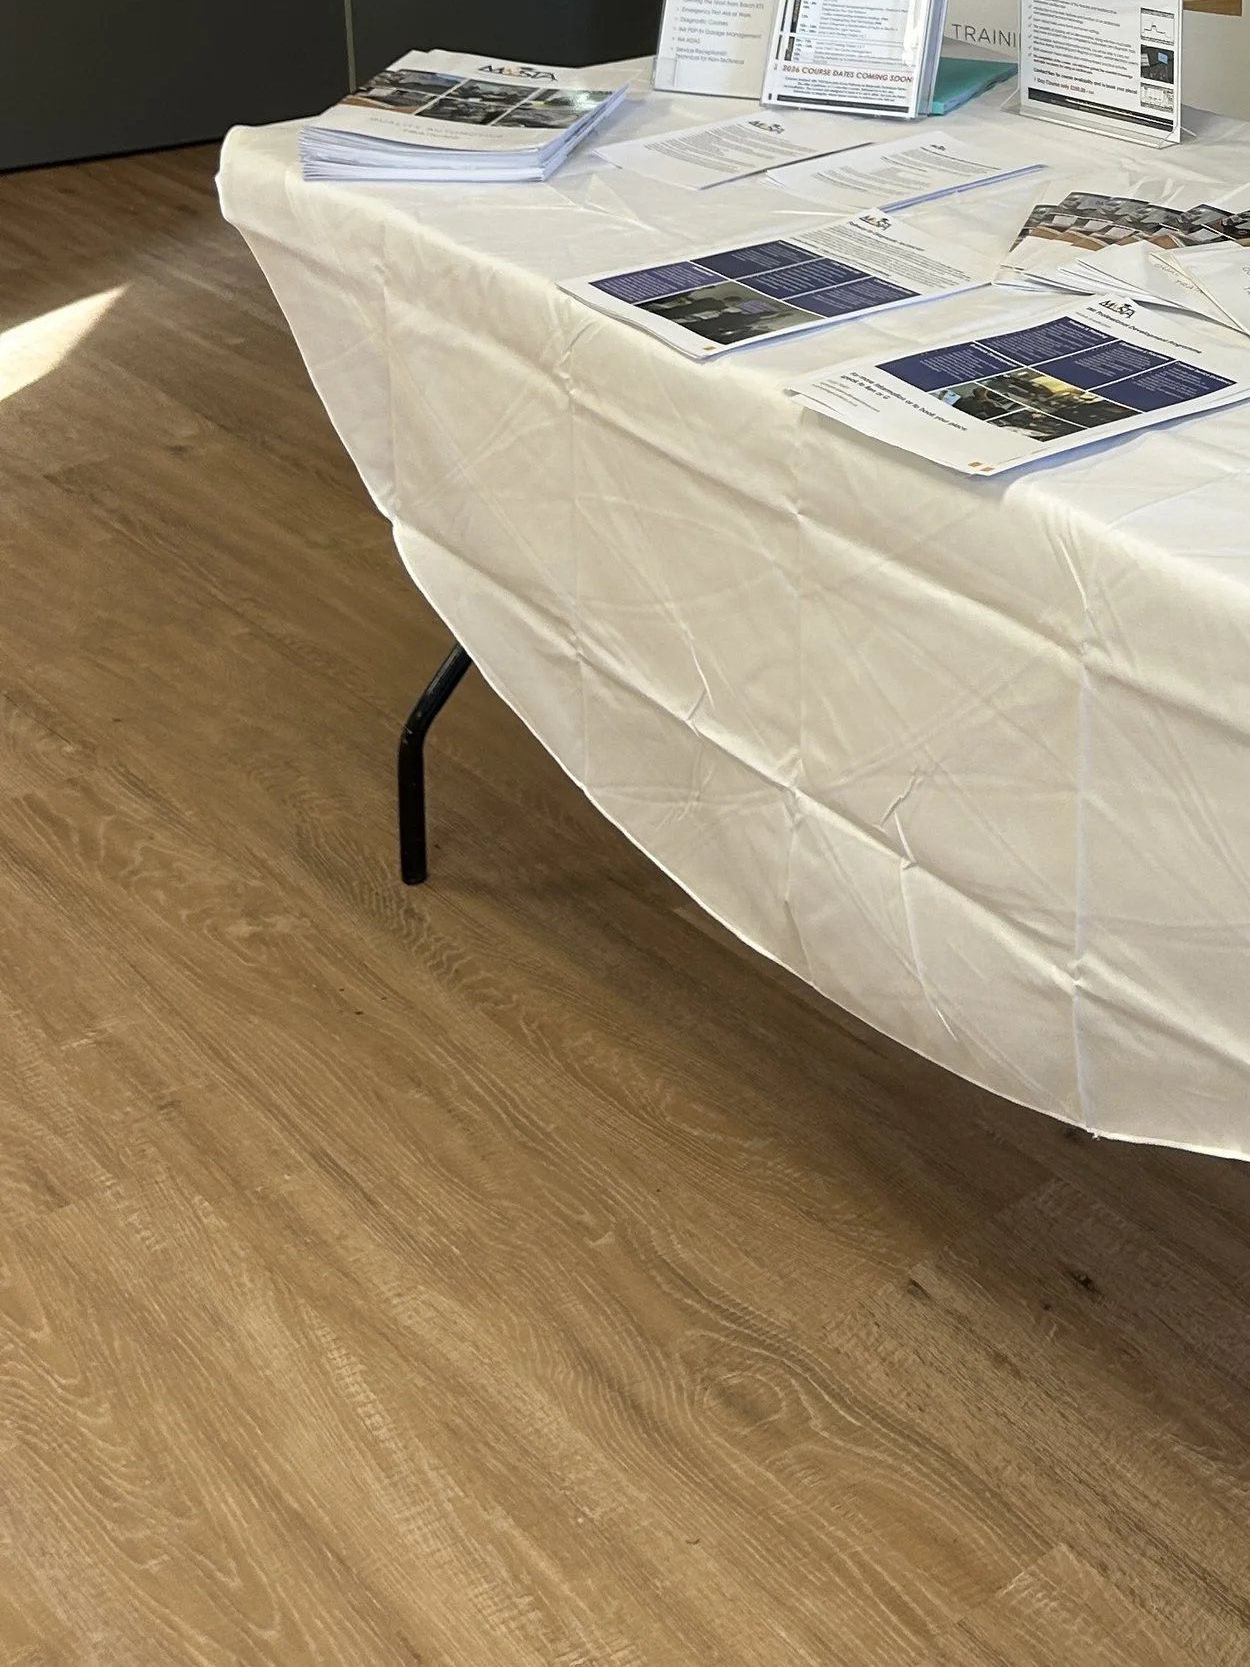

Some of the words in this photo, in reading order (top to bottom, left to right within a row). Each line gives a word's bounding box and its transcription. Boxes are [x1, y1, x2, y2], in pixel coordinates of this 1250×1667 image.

[801, 66, 831, 76] COURSE
[832, 69, 854, 78] DATES
[855, 71, 888, 81] COMING
